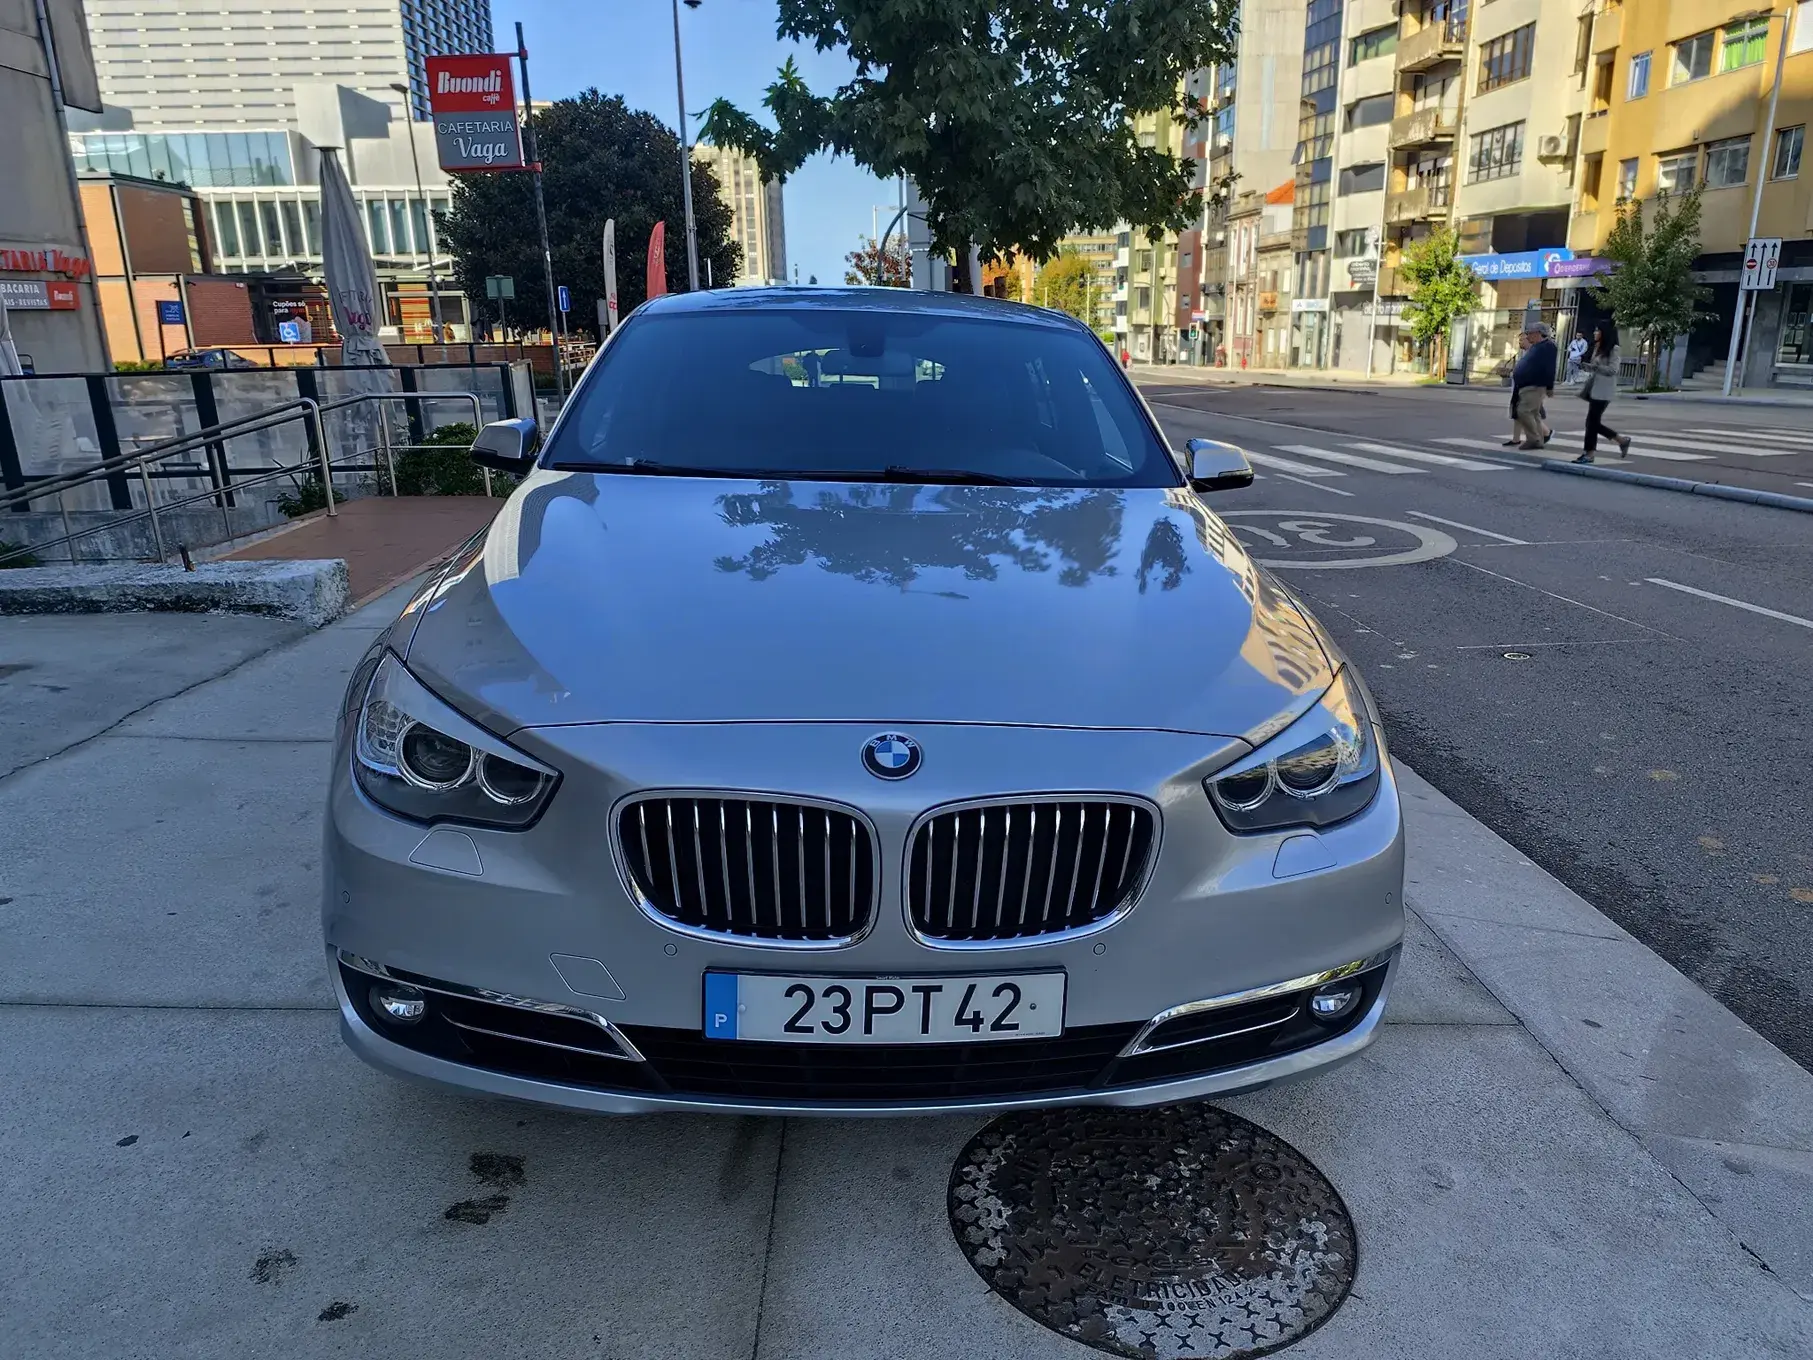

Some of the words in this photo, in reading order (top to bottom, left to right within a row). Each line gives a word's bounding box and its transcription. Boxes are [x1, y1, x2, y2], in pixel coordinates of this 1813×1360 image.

[437, 70, 502, 94] Buondi
[438, 121, 514, 134] CAFETARIA
[453, 136, 509, 164] Vaga
[869, 734, 917, 748] BMW
[714, 1013, 728, 1028] P
